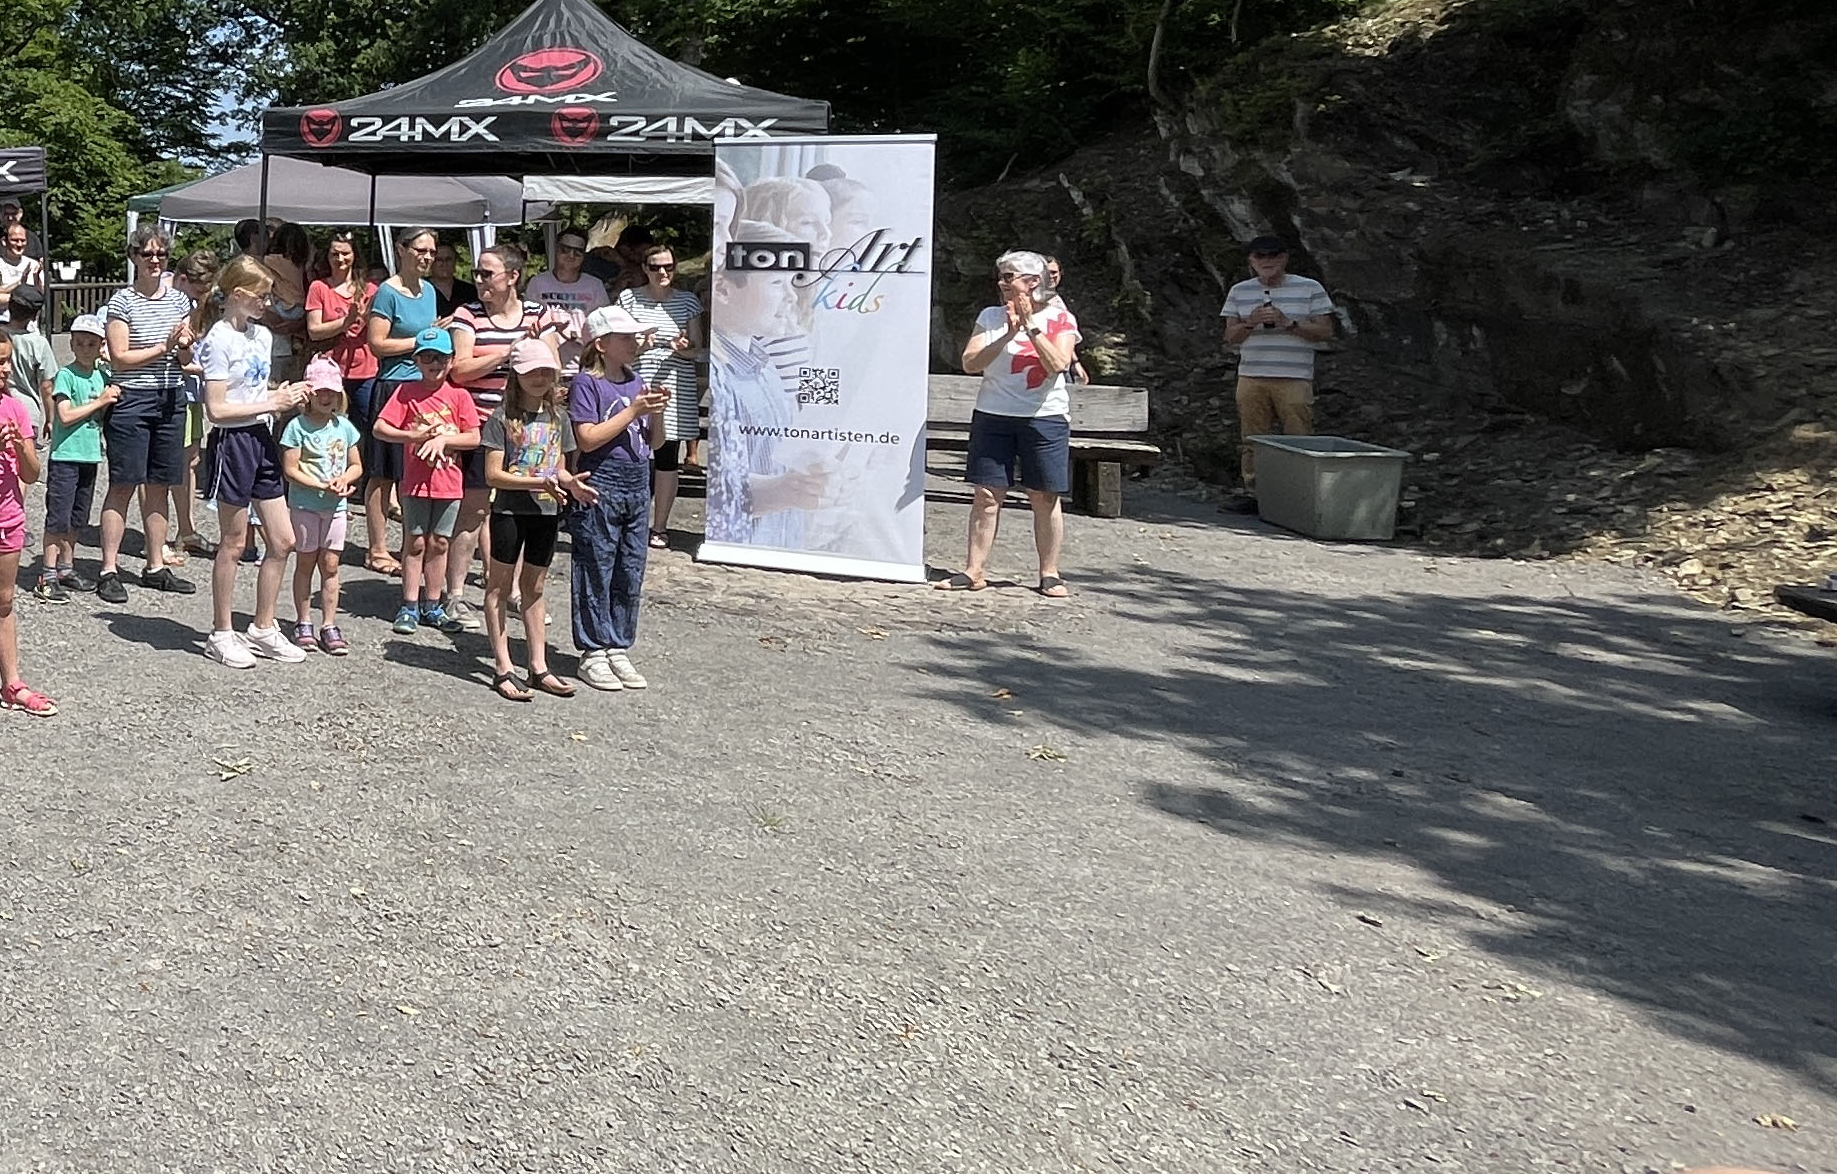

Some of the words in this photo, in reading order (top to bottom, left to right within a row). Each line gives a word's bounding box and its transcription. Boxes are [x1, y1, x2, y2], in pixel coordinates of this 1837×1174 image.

[453, 91, 619, 109] 24MX
[347, 115, 501, 143] 24MX
[606, 116, 779, 144] 24MX
[730, 244, 806, 269] ton
[812, 260, 906, 315] kids
[738, 424, 901, 445] www.tonartisten.de
